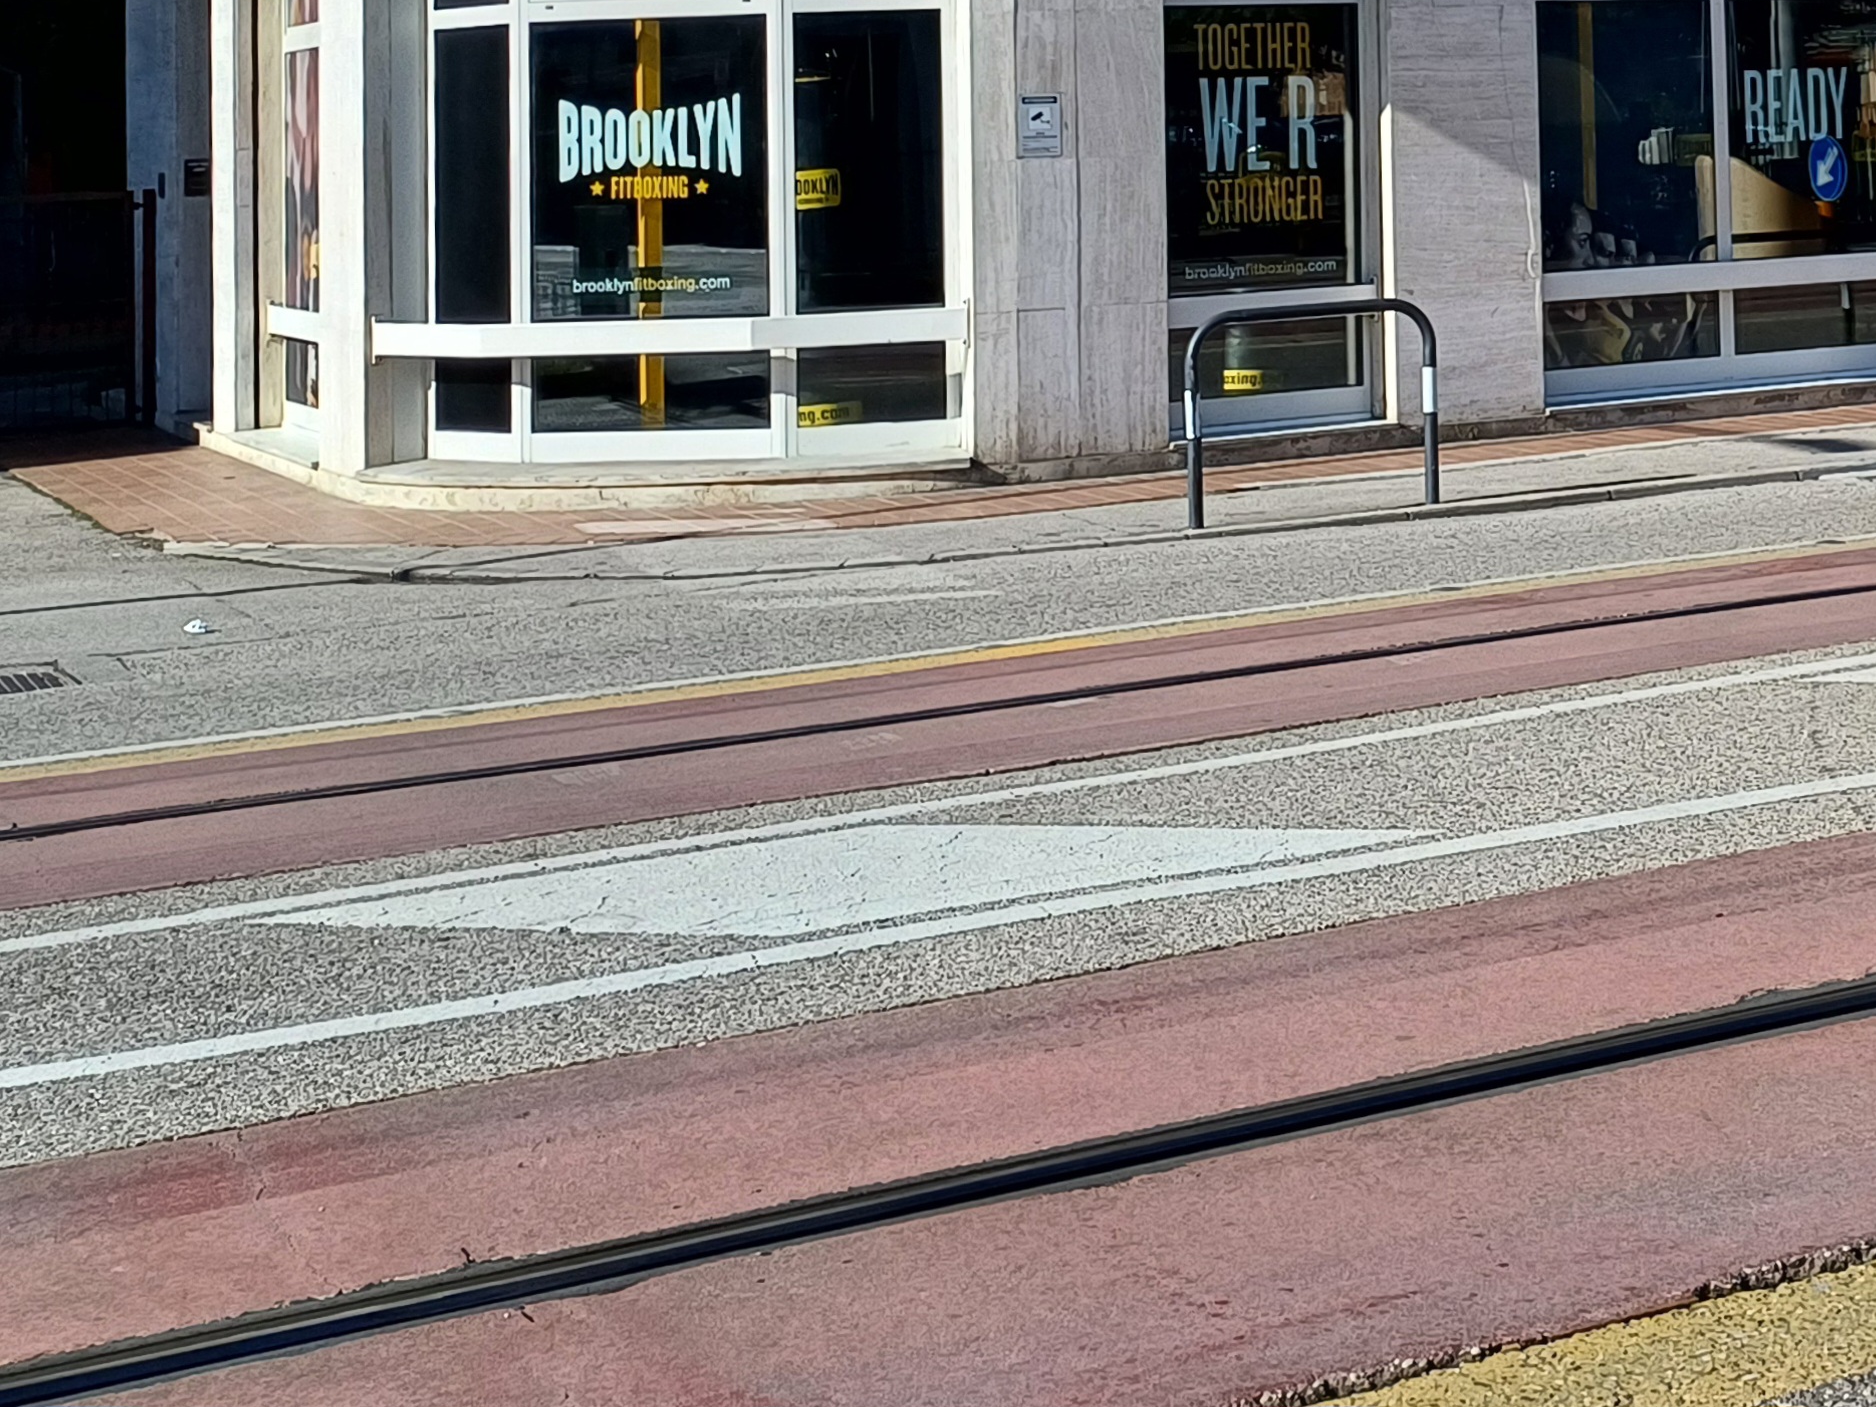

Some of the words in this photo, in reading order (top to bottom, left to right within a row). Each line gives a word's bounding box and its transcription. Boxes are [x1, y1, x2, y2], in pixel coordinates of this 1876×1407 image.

[1194, 22, 1311, 70] TOGETHER
[1199, 75, 1271, 173] WE
[1287, 75, 1319, 170] R
[1743, 67, 1848, 143] READY
[558, 92, 742, 183] BROOKLYN
[610, 175, 689, 199] FITBOXING
[1206, 175, 1324, 225] STRONGER
[572, 276, 731, 295] brooklynfitboxing.com
[1184, 260, 1337, 281] brooklynfitboxing.com
